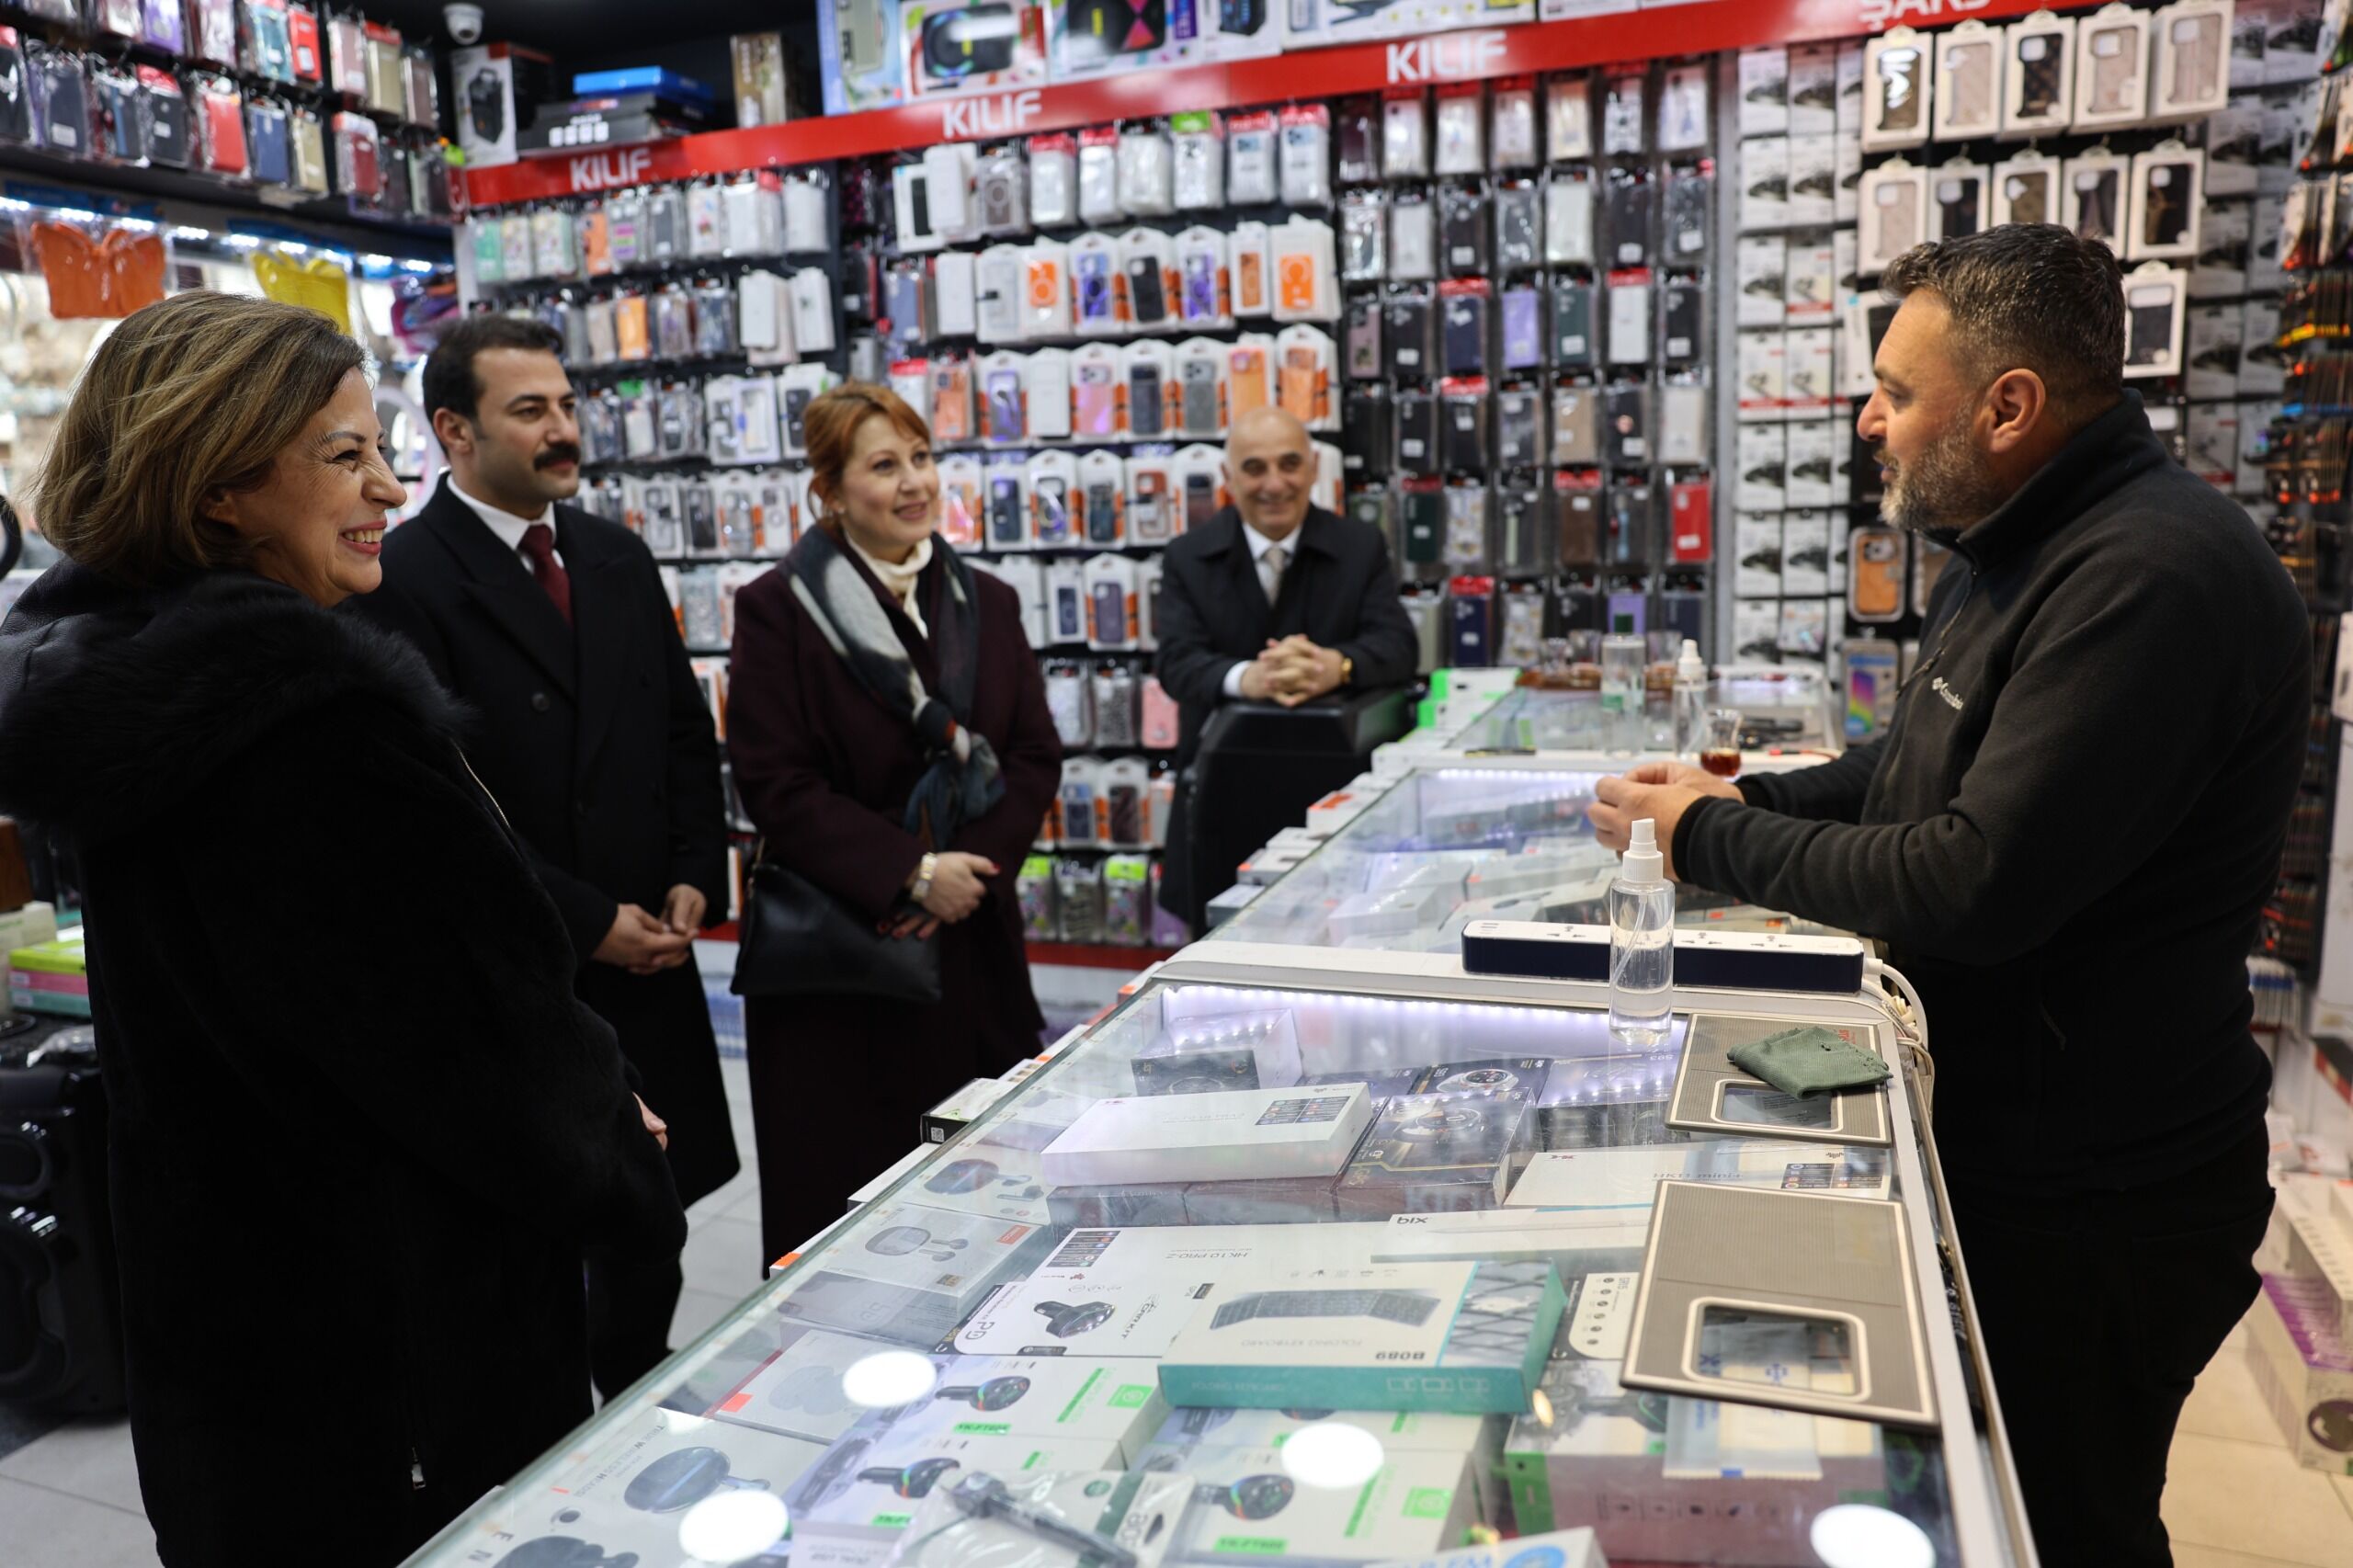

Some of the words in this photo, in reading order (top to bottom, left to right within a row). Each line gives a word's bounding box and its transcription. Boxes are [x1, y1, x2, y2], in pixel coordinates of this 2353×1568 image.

[1386, 30, 1507, 84] KILIF
[942, 89, 1043, 139] KILIF
[570, 146, 652, 193] KILIF
